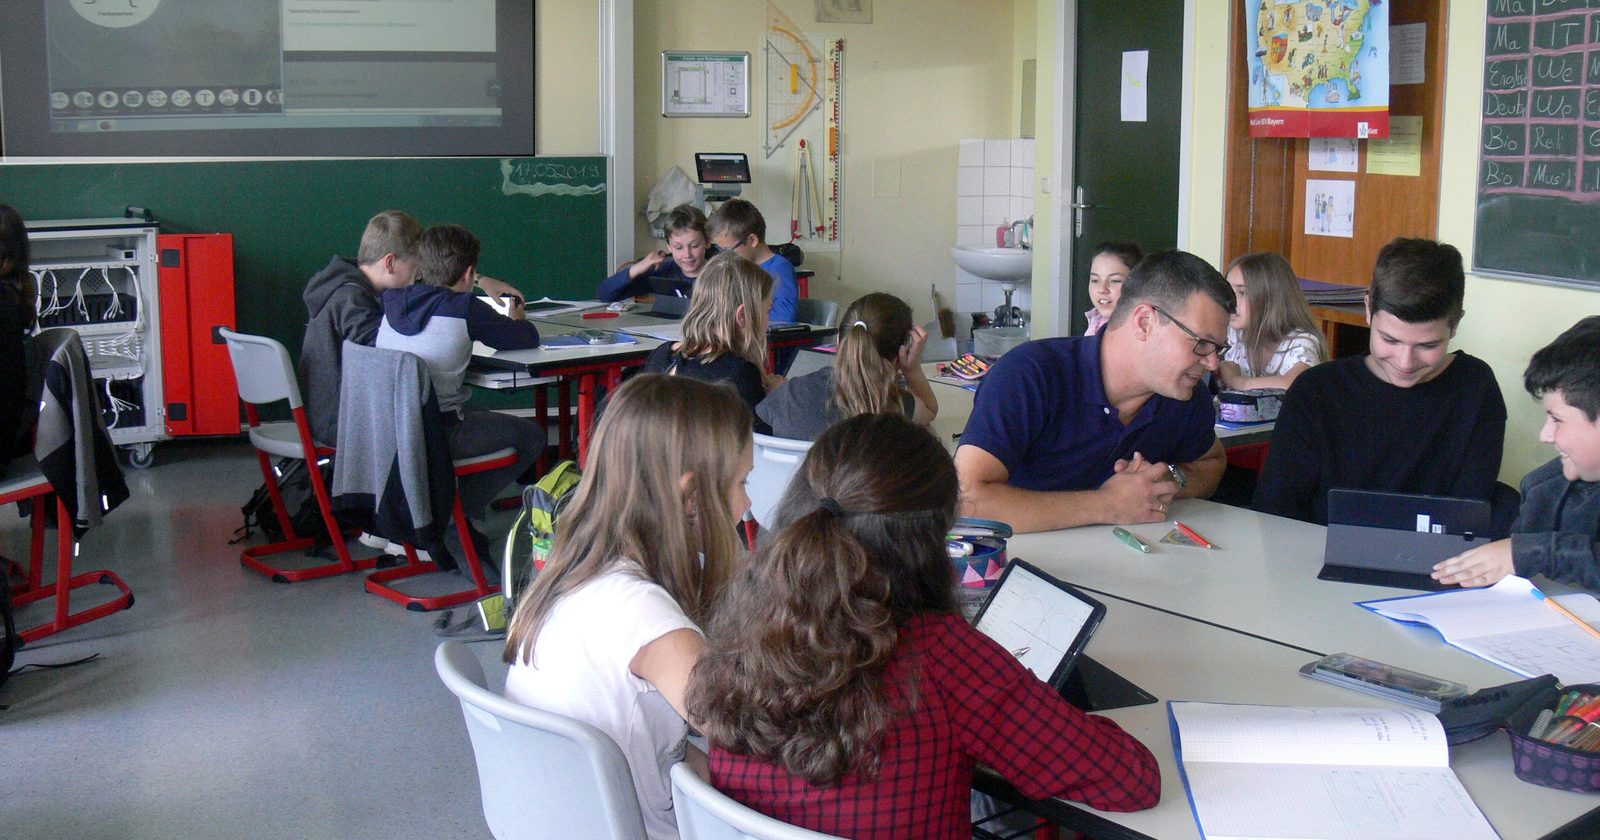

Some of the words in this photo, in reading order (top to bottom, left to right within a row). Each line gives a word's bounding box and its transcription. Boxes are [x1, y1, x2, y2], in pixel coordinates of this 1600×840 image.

[1493, 24, 1521, 52] Ma
[1551, 22, 1580, 47] IT
[1537, 58, 1574, 83] We
[1484, 125, 1518, 151] Bio
[1486, 161, 1513, 185] Bio
